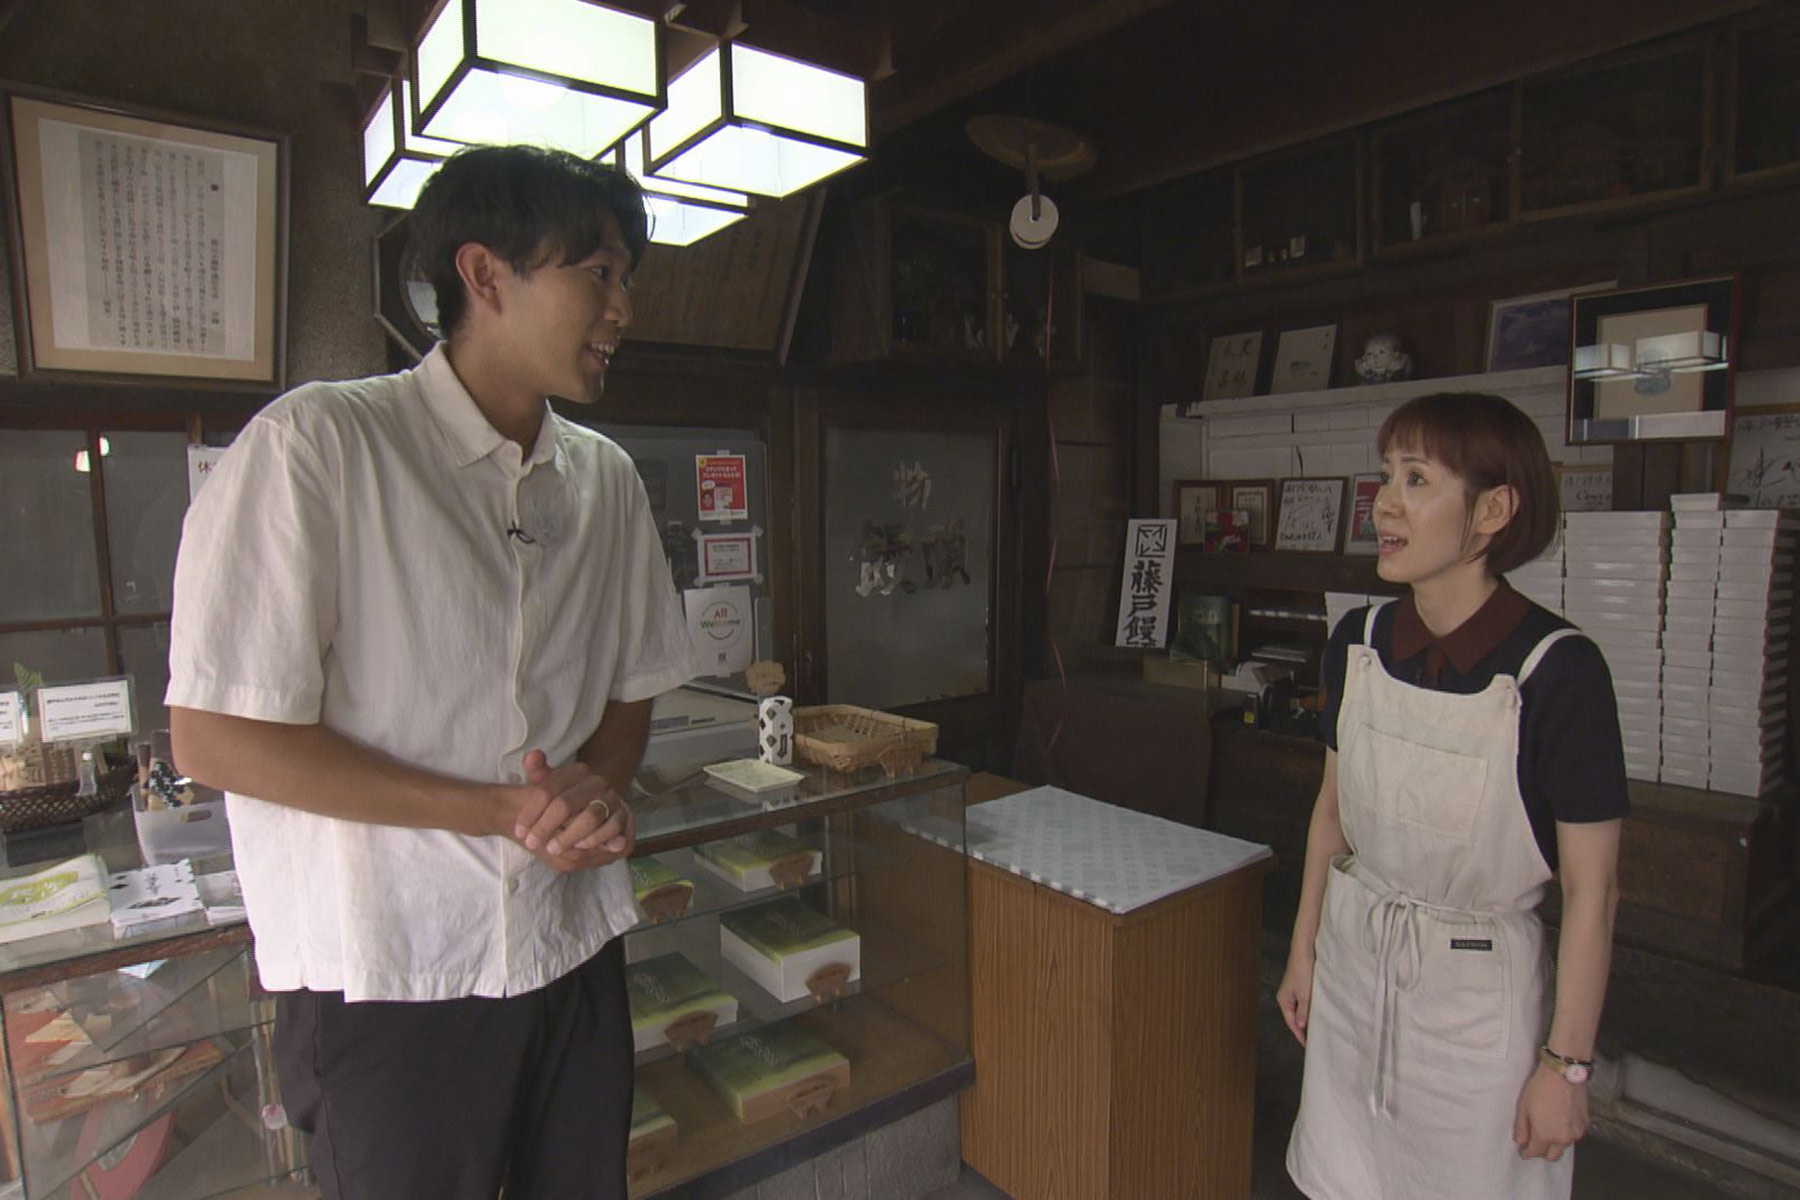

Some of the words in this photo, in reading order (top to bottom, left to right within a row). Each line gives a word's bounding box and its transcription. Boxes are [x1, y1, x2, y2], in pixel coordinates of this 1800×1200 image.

[714, 608, 728, 618] All
[1123, 559, 1165, 647] 藤戸饅
